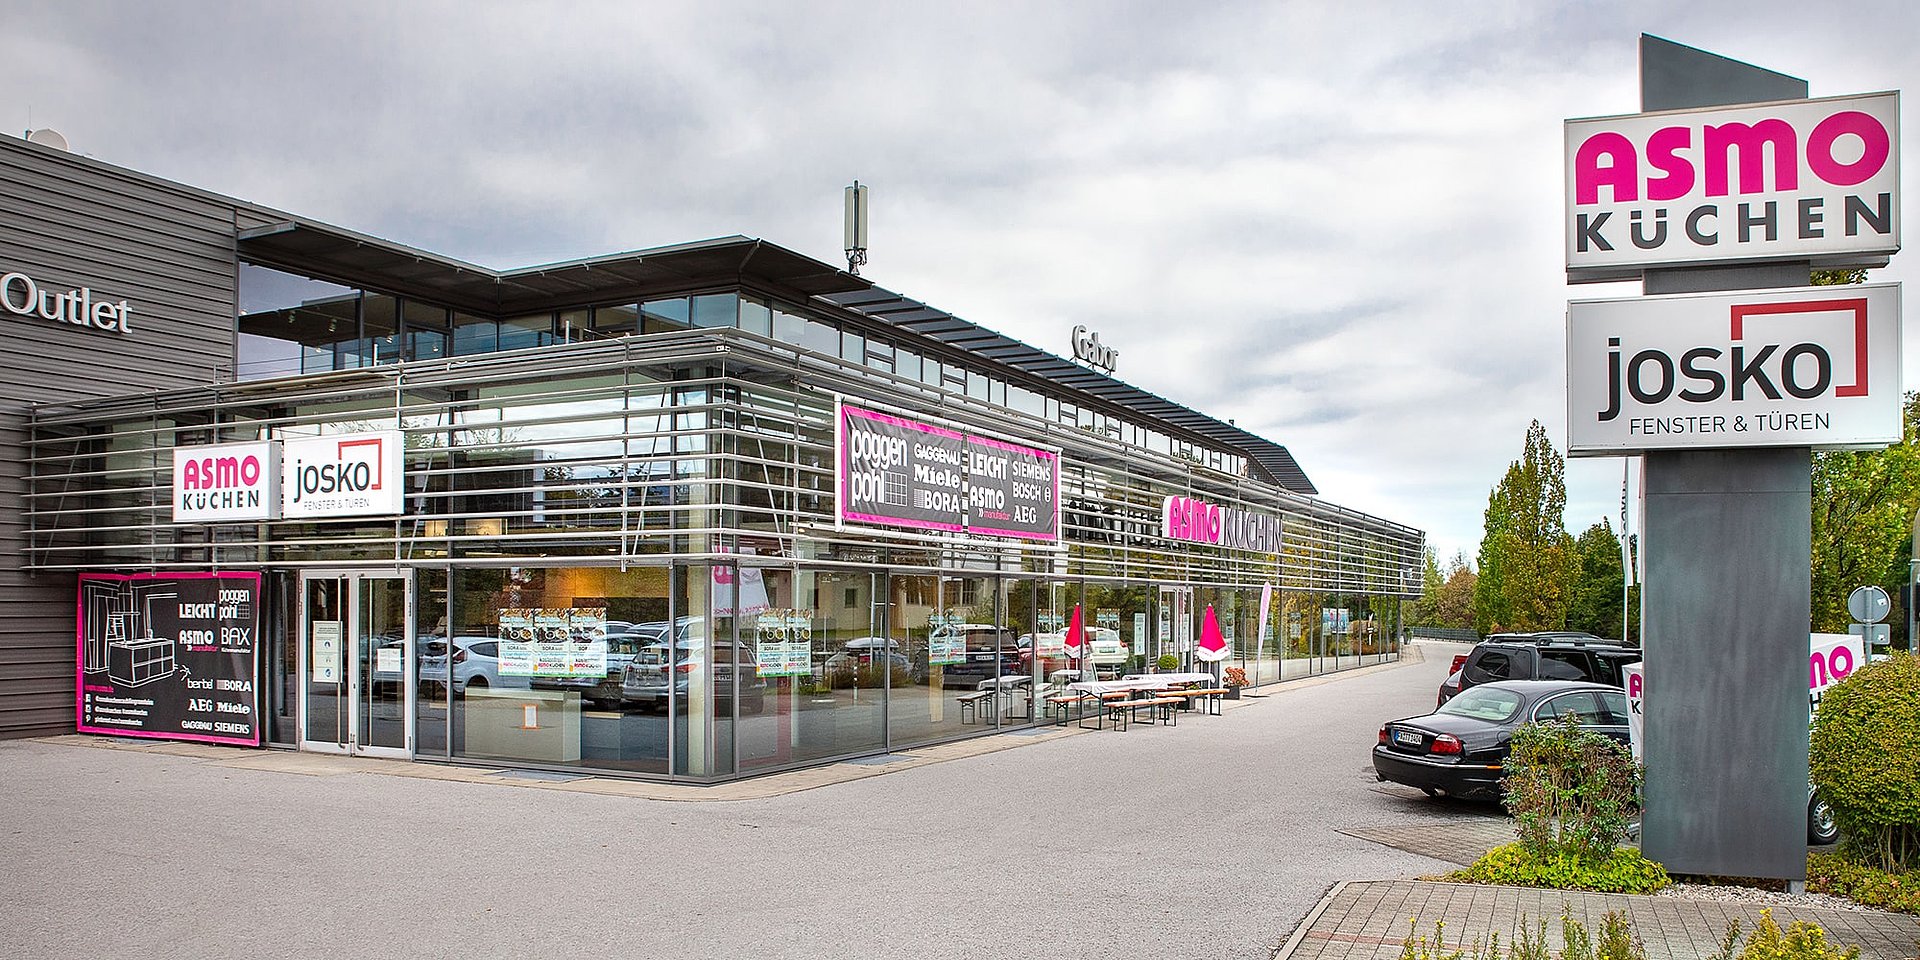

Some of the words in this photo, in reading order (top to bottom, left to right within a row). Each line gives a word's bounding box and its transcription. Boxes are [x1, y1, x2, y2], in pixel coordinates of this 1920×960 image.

[1575, 111, 1890, 205] ASMO
[1576, 193, 1891, 253] KÜCHEN
[0, 272, 133, 334] Outlet
[1071, 324, 1119, 372] Gabor
[1630, 417, 1726, 436] FENSTER
[1733, 416, 1748, 433] &
[1755, 411, 1830, 432] TÜREN
[852, 428, 908, 470] poggen
[913, 442, 960, 466] GAGGENAU
[184, 455, 260, 490] ASMO
[913, 463, 960, 489] Miele
[969, 452, 1007, 480] LEICHT
[1012, 460, 1051, 482] SIEMENS
[183, 490, 259, 510] KÜCHEN
[852, 469, 886, 507] pohl
[969, 485, 1005, 510] ASMO
[1012, 481, 1042, 502] BOSCH
[924, 489, 960, 513] BORA
[1013, 504, 1037, 524] AEG
[1169, 495, 1221, 544] ASMO
[218, 589, 250, 605] poggen
[179, 602, 216, 619] LEICHT
[218, 604, 238, 621] pohl
[179, 629, 215, 645] ASMO
[221, 627, 251, 646] BAX
[224, 679, 252, 692] BORA
[188, 698, 213, 713] AEG
[216, 701, 251, 715] Miele
[214, 721, 250, 735] SIEMENS
